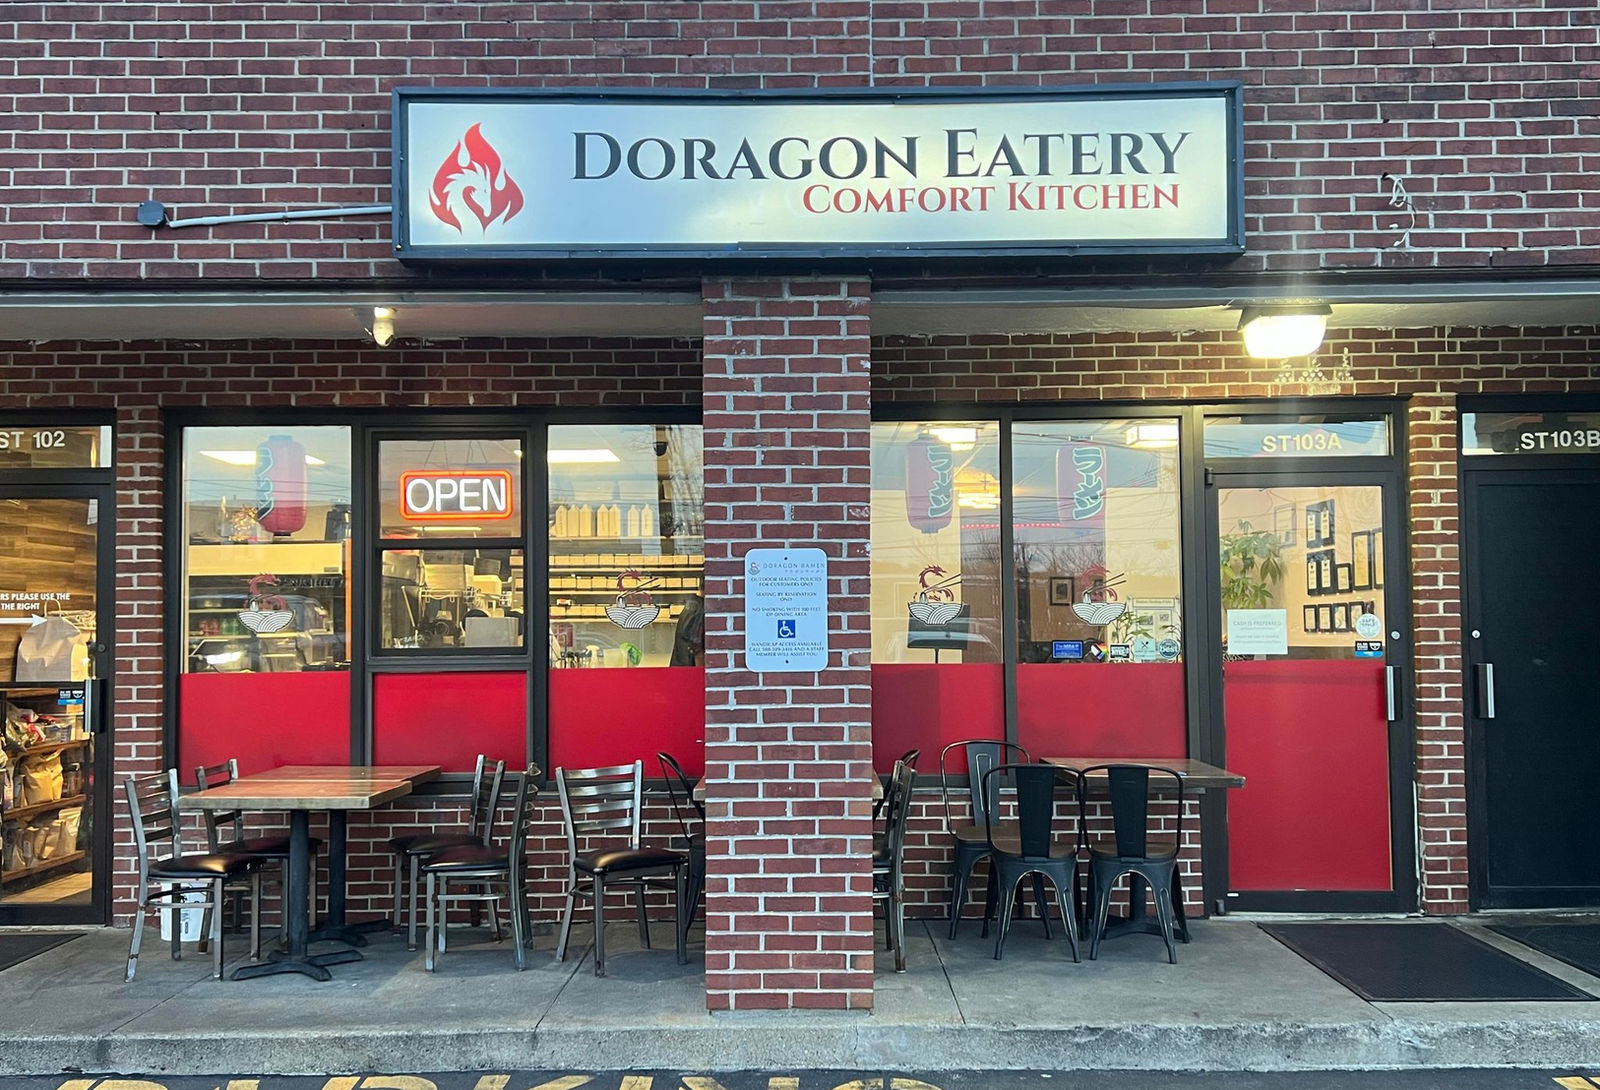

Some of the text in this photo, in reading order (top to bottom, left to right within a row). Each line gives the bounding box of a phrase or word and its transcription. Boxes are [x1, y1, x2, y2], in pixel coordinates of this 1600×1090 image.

[570, 128, 1193, 180] DORAGON EATERY
[803, 181, 1181, 214] COMFORT KITCHEN
[33, 430, 65, 448] 102
[1262, 433, 1342, 452] ST103A
[1520, 430, 1600, 449] ST103B
[406, 478, 506, 512] OPEN
